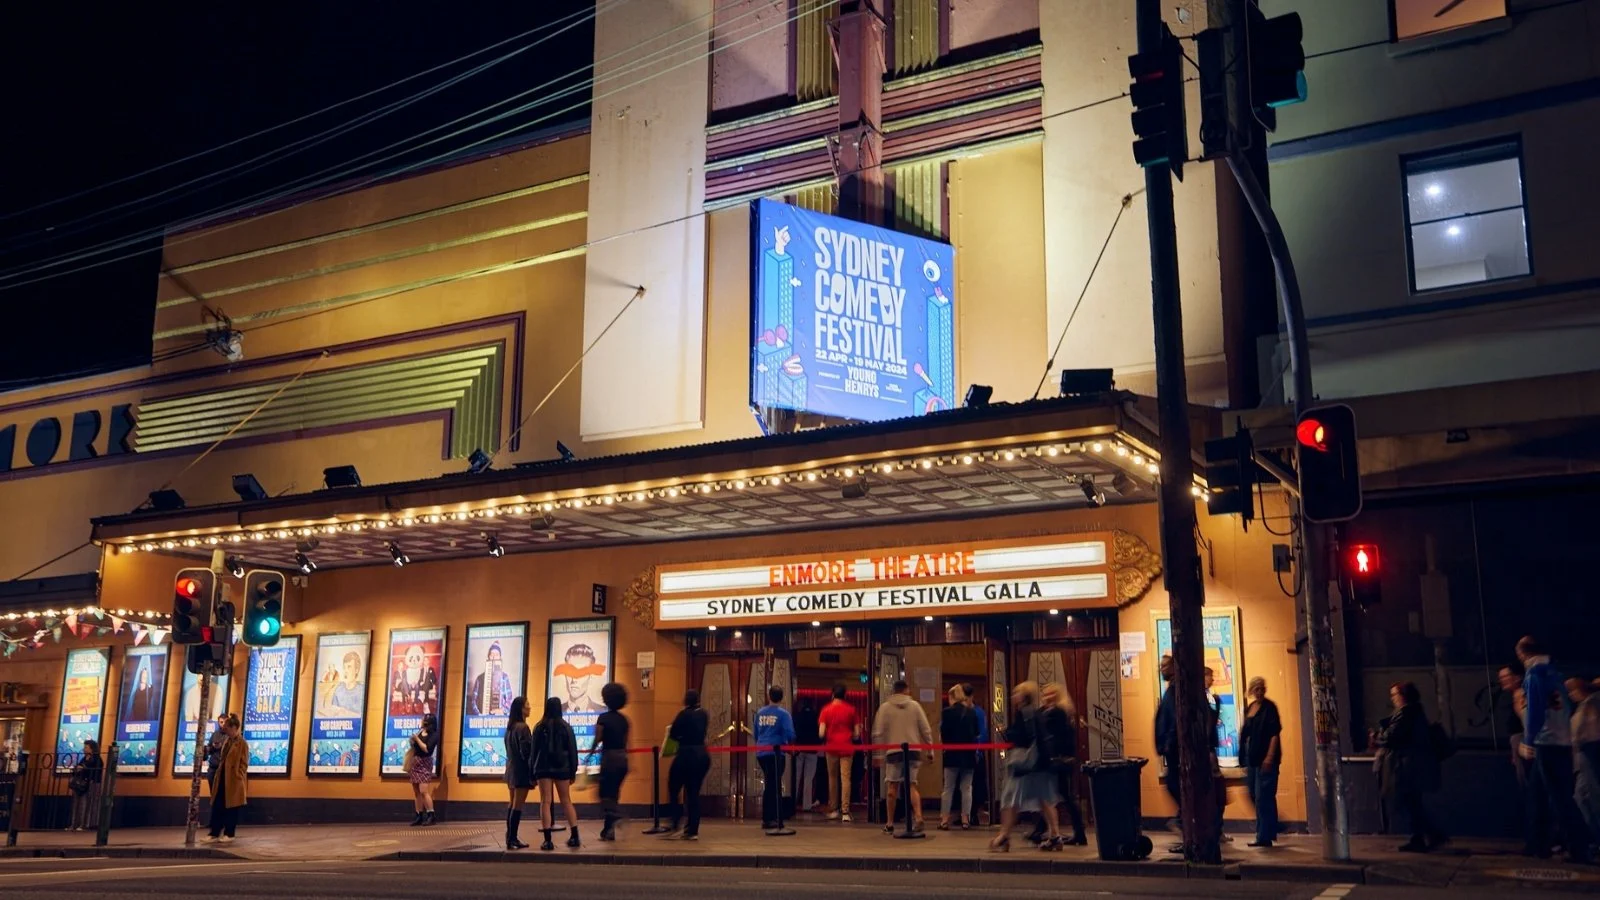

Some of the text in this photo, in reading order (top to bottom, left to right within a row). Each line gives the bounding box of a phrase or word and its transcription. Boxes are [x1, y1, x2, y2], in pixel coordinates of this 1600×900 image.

[814, 226, 905, 287] SYDNEY
[814, 268, 907, 329] COMEDY
[814, 310, 908, 366] FESTIVAL
[815, 349, 827, 360] 22
[828, 351, 848, 364] APR
[854, 356, 864, 367] 19
[865, 359, 885, 371] MAY
[885, 363, 908, 375] 2024
[847, 365, 877, 384] YOUNG
[844, 378, 880, 398] HENRYS
[769, 551, 976, 587] ENMORE THEATRE
[707, 581, 1043, 615] SYDNEY COMEDY FESTIVAL GALA
[260, 652, 288, 668] SYDNEY
[256, 682, 284, 697] FESTIVAL
[256, 696, 281, 713] GALA
